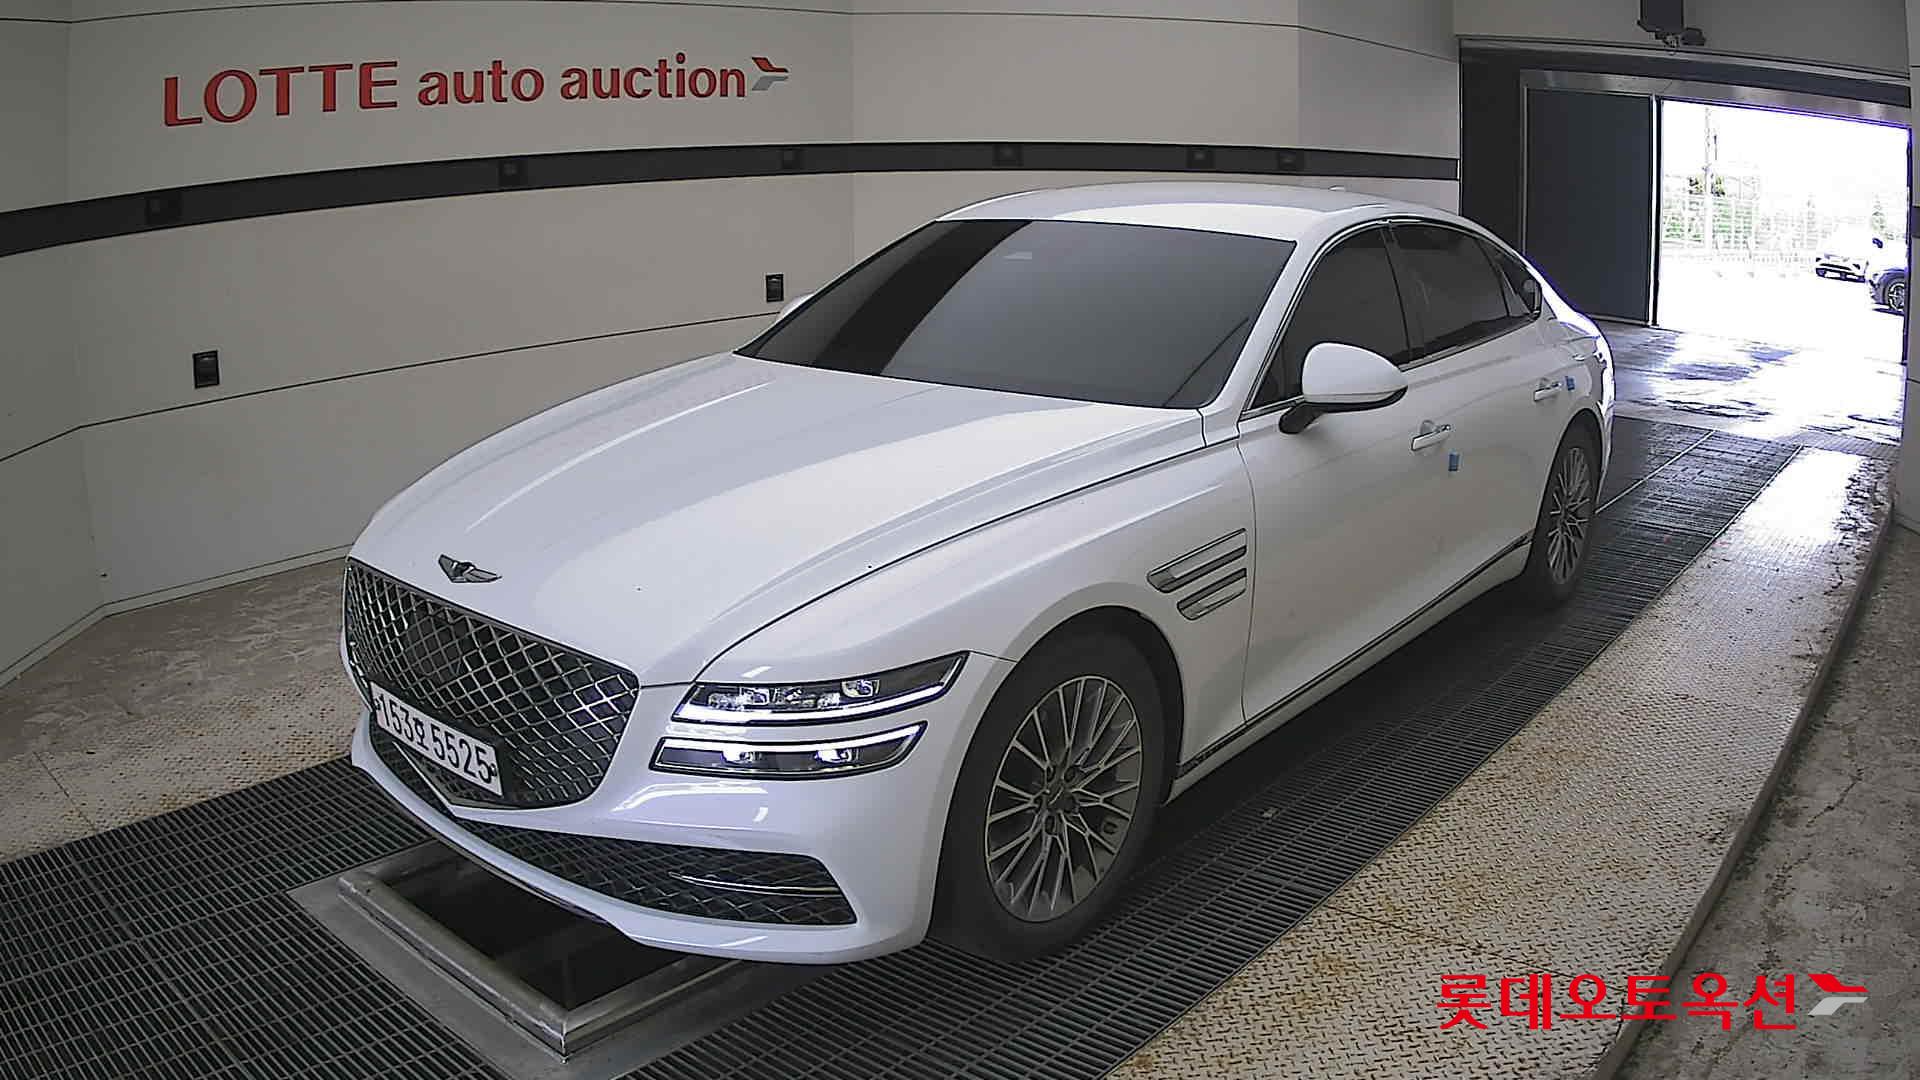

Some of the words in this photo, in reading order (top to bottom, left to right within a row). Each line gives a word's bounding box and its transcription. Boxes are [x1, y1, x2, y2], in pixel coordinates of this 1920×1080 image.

[164, 61, 398, 127] LOTTE
[417, 60, 544, 106] auto
[560, 52, 747, 101] auction
[430, 723, 493, 784] 5525
